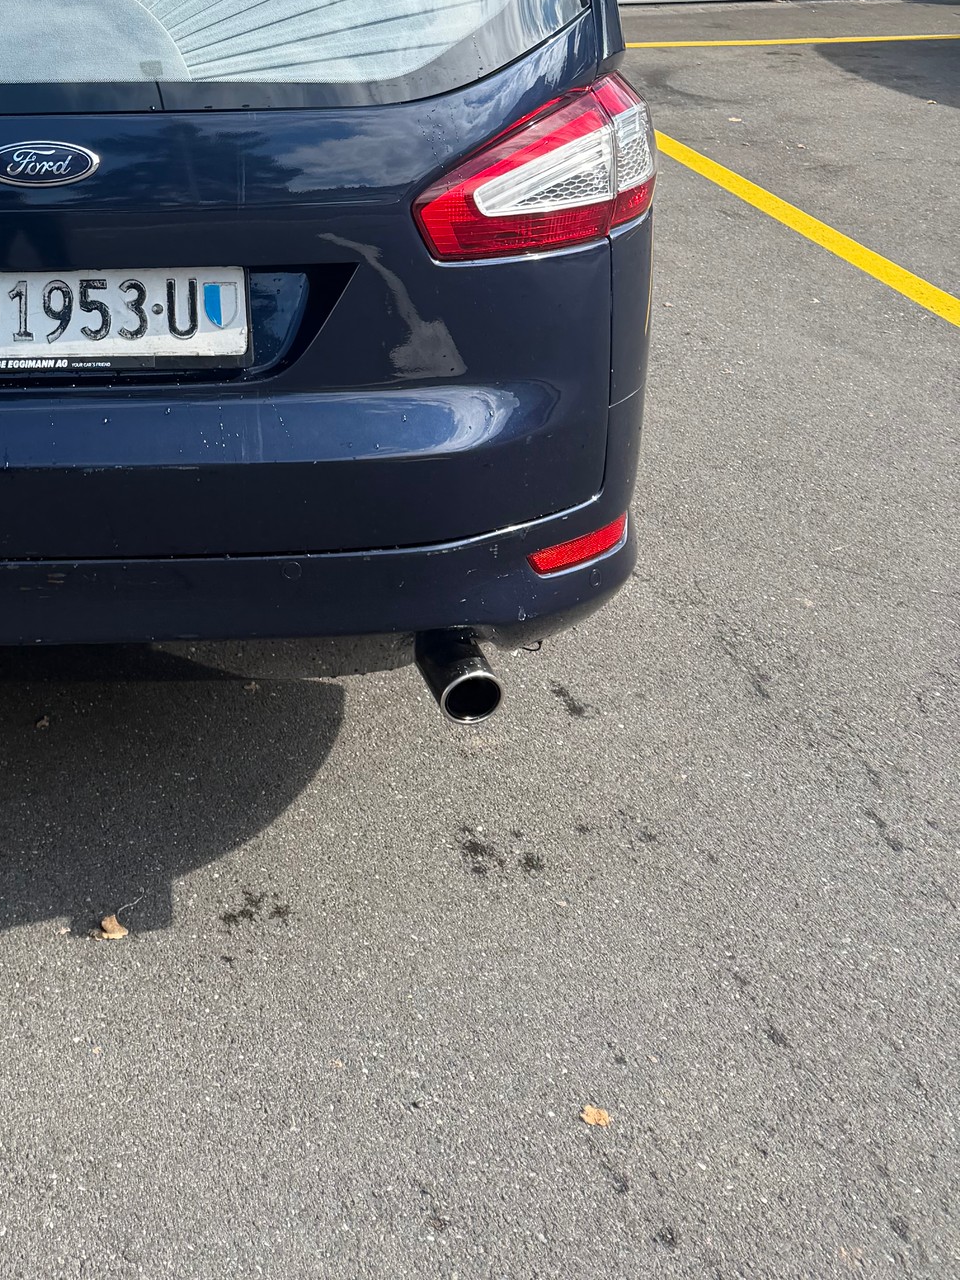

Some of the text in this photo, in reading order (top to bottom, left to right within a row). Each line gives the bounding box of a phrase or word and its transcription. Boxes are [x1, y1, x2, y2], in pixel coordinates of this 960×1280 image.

[6, 149, 72, 176] Ford
[7, 360, 55, 369] EGGIMANN
[55, 359, 68, 368] AG
